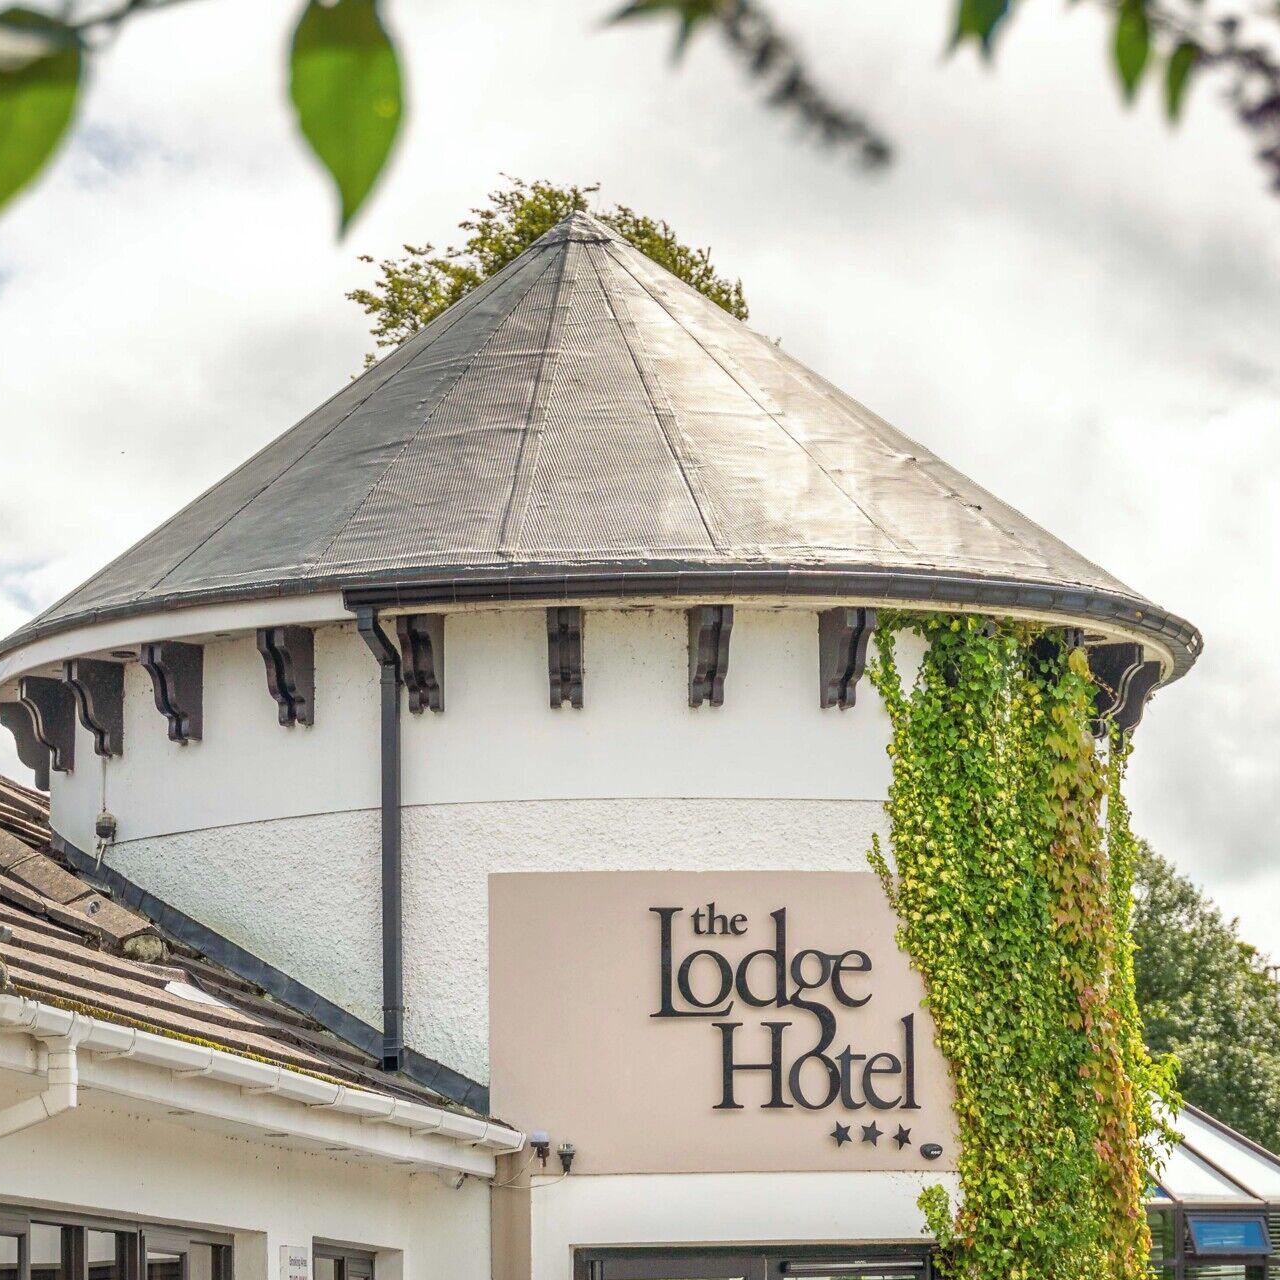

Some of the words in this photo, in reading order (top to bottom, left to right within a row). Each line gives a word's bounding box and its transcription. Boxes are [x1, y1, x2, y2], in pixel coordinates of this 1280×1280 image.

[691, 902, 748, 936] the
[649, 907, 873, 1050] Lodge
[712, 1012, 922, 1111] Hotel
